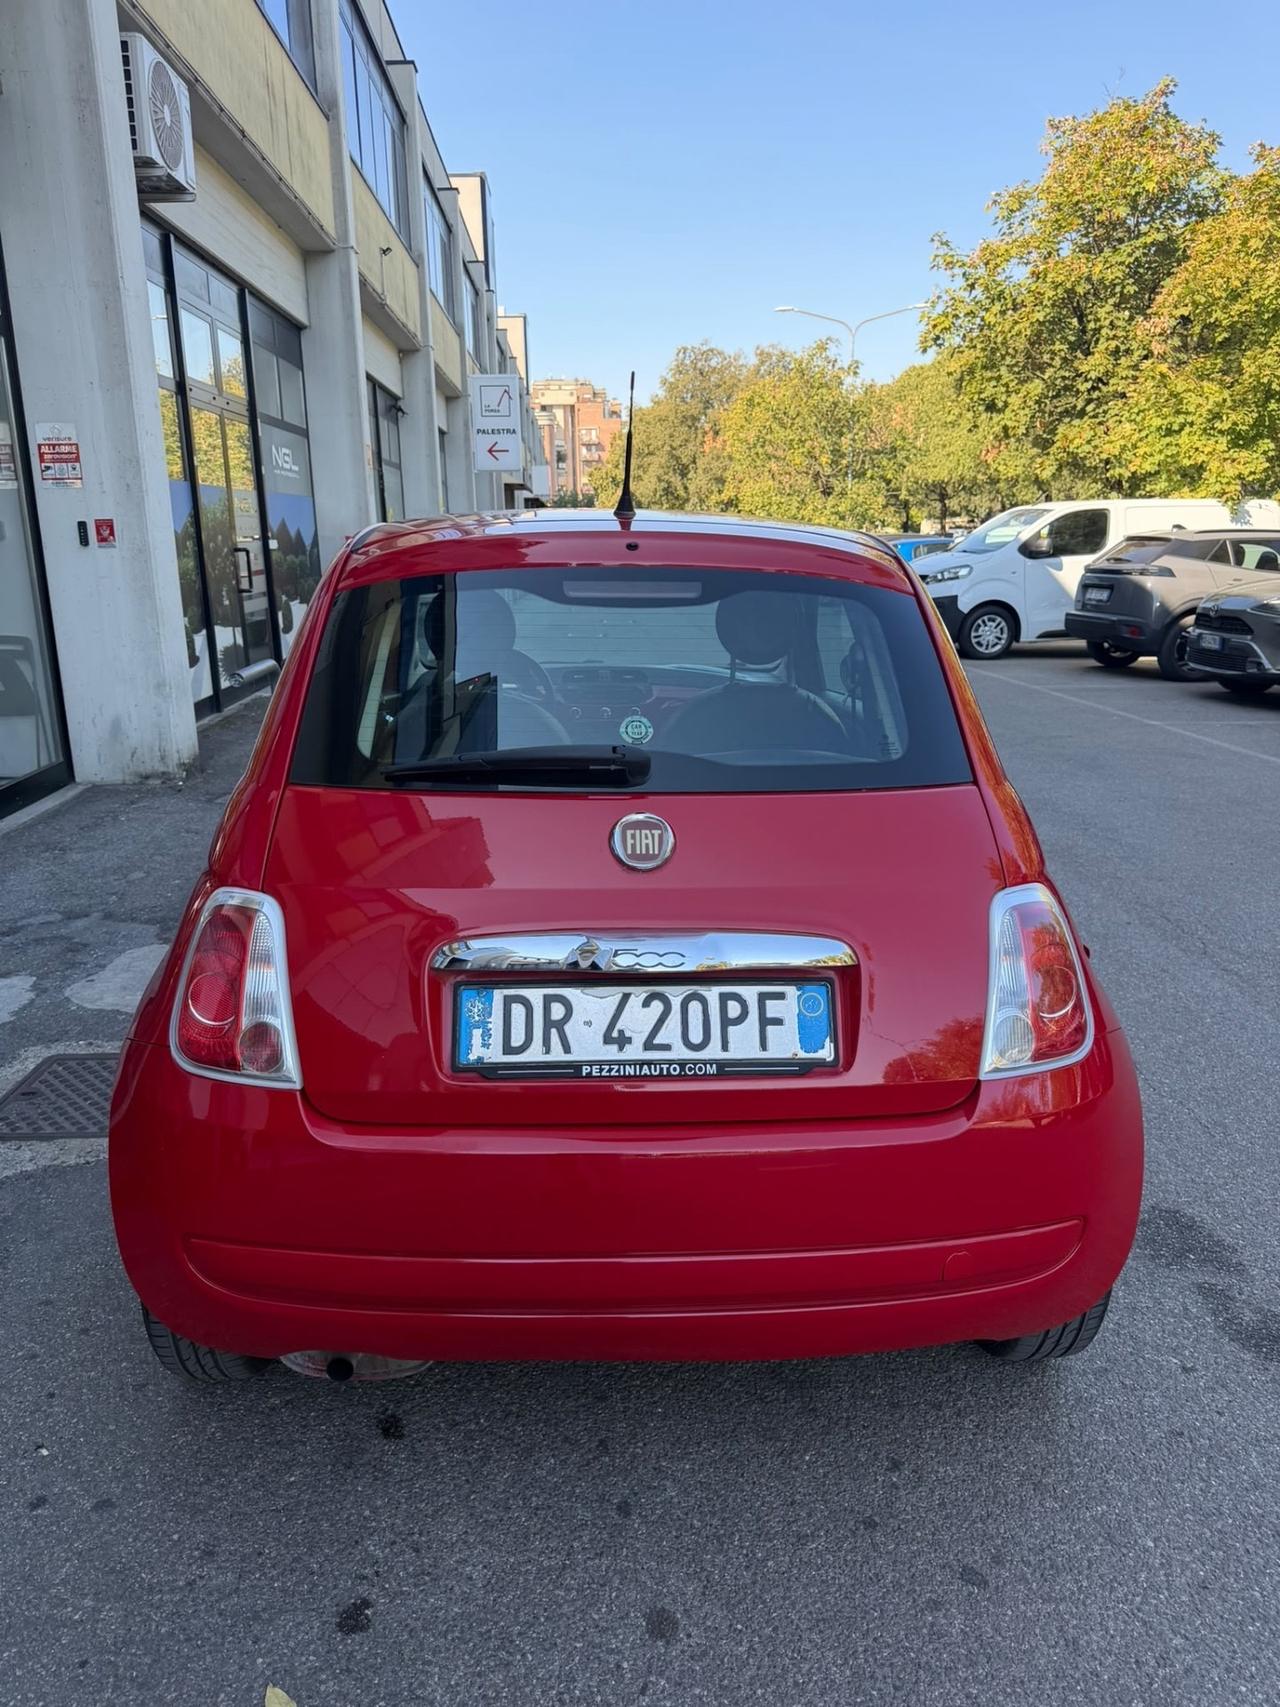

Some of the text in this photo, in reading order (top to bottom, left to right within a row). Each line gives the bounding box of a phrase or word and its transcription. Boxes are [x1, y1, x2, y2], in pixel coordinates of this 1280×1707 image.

[477, 428, 517, 436] PALESTRA
[40, 444, 78, 453] ALLARME
[626, 829, 661, 854] FIAT
[612, 948, 686, 968] 500
[502, 991, 787, 1055] DR 420PF
[582, 1063, 717, 1077] PEZZINIAUTO.COM
